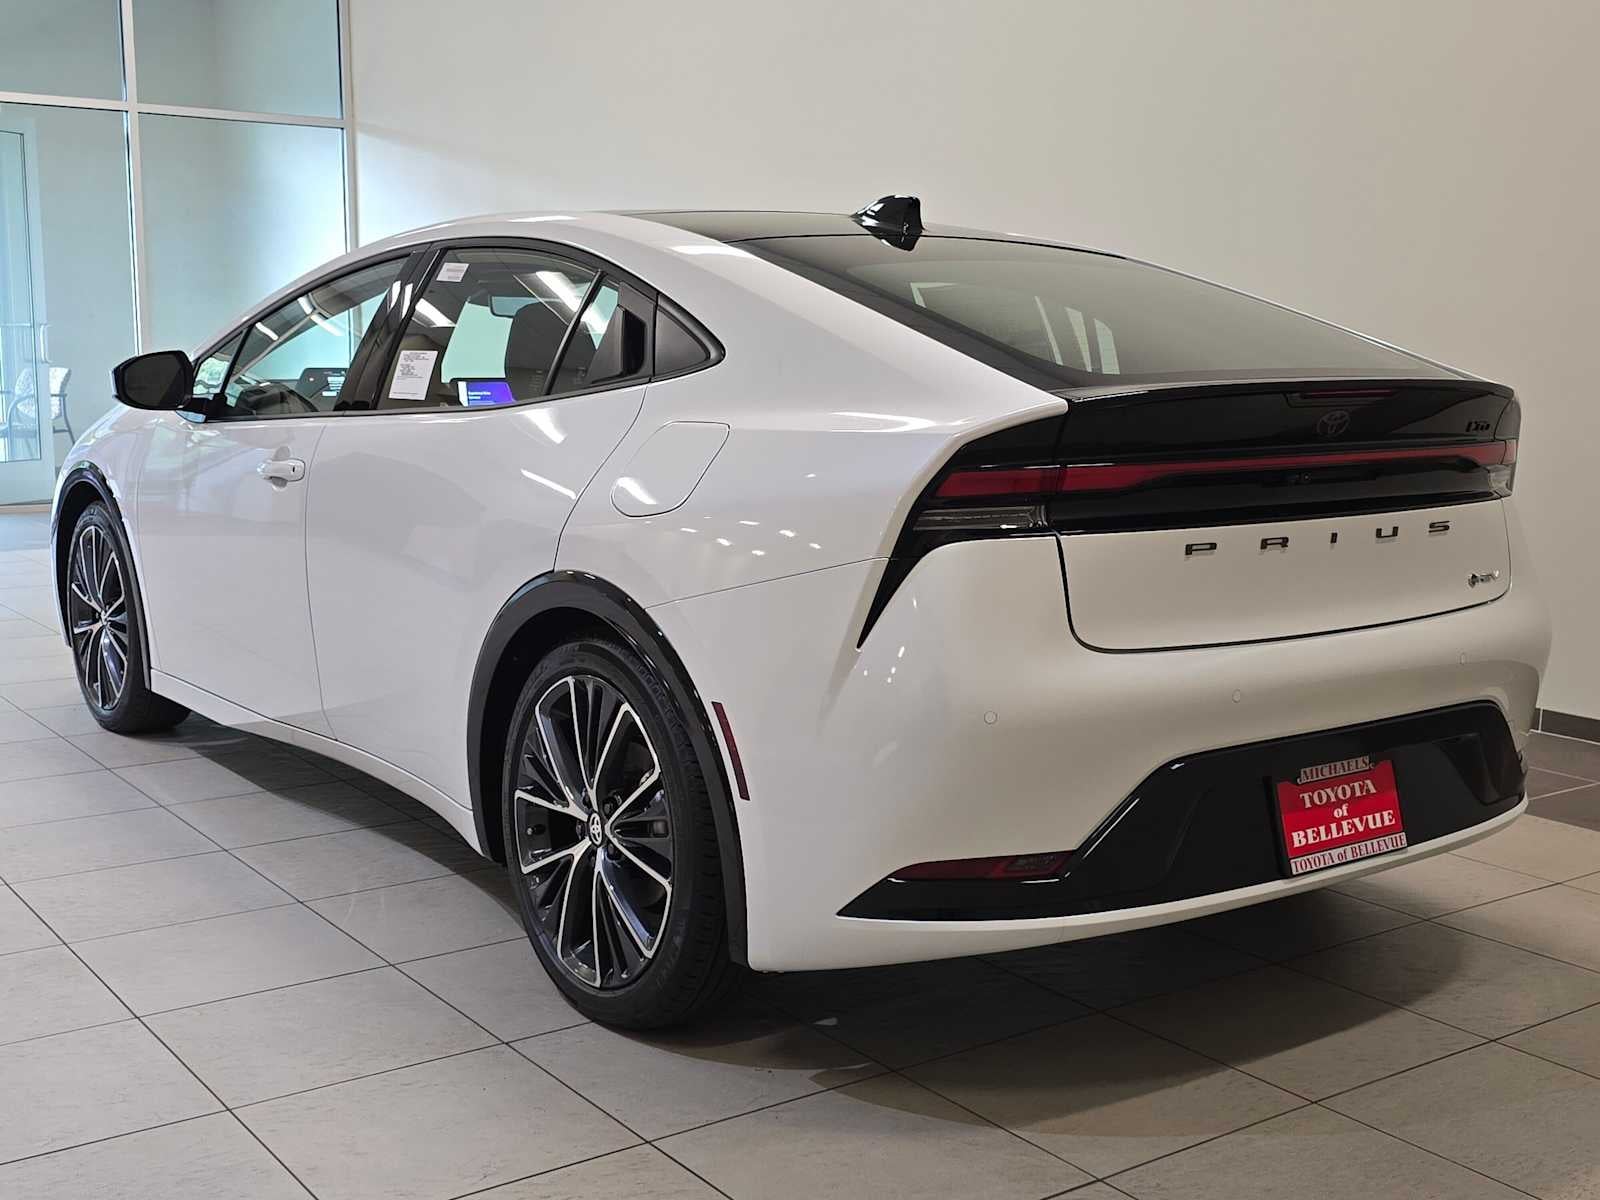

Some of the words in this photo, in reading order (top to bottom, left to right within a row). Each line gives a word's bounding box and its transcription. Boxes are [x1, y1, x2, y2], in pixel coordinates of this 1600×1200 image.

[1184, 520, 1451, 557] PRIUS
[1300, 780, 1377, 808] TOYOTA
[1333, 803, 1349, 818] of
[1291, 810, 1396, 848] BELLEVUE
[1292, 853, 1335, 873] TOYOTA
[1337, 848, 1348, 862] of
[1350, 835, 1406, 859] BELLEVUE
